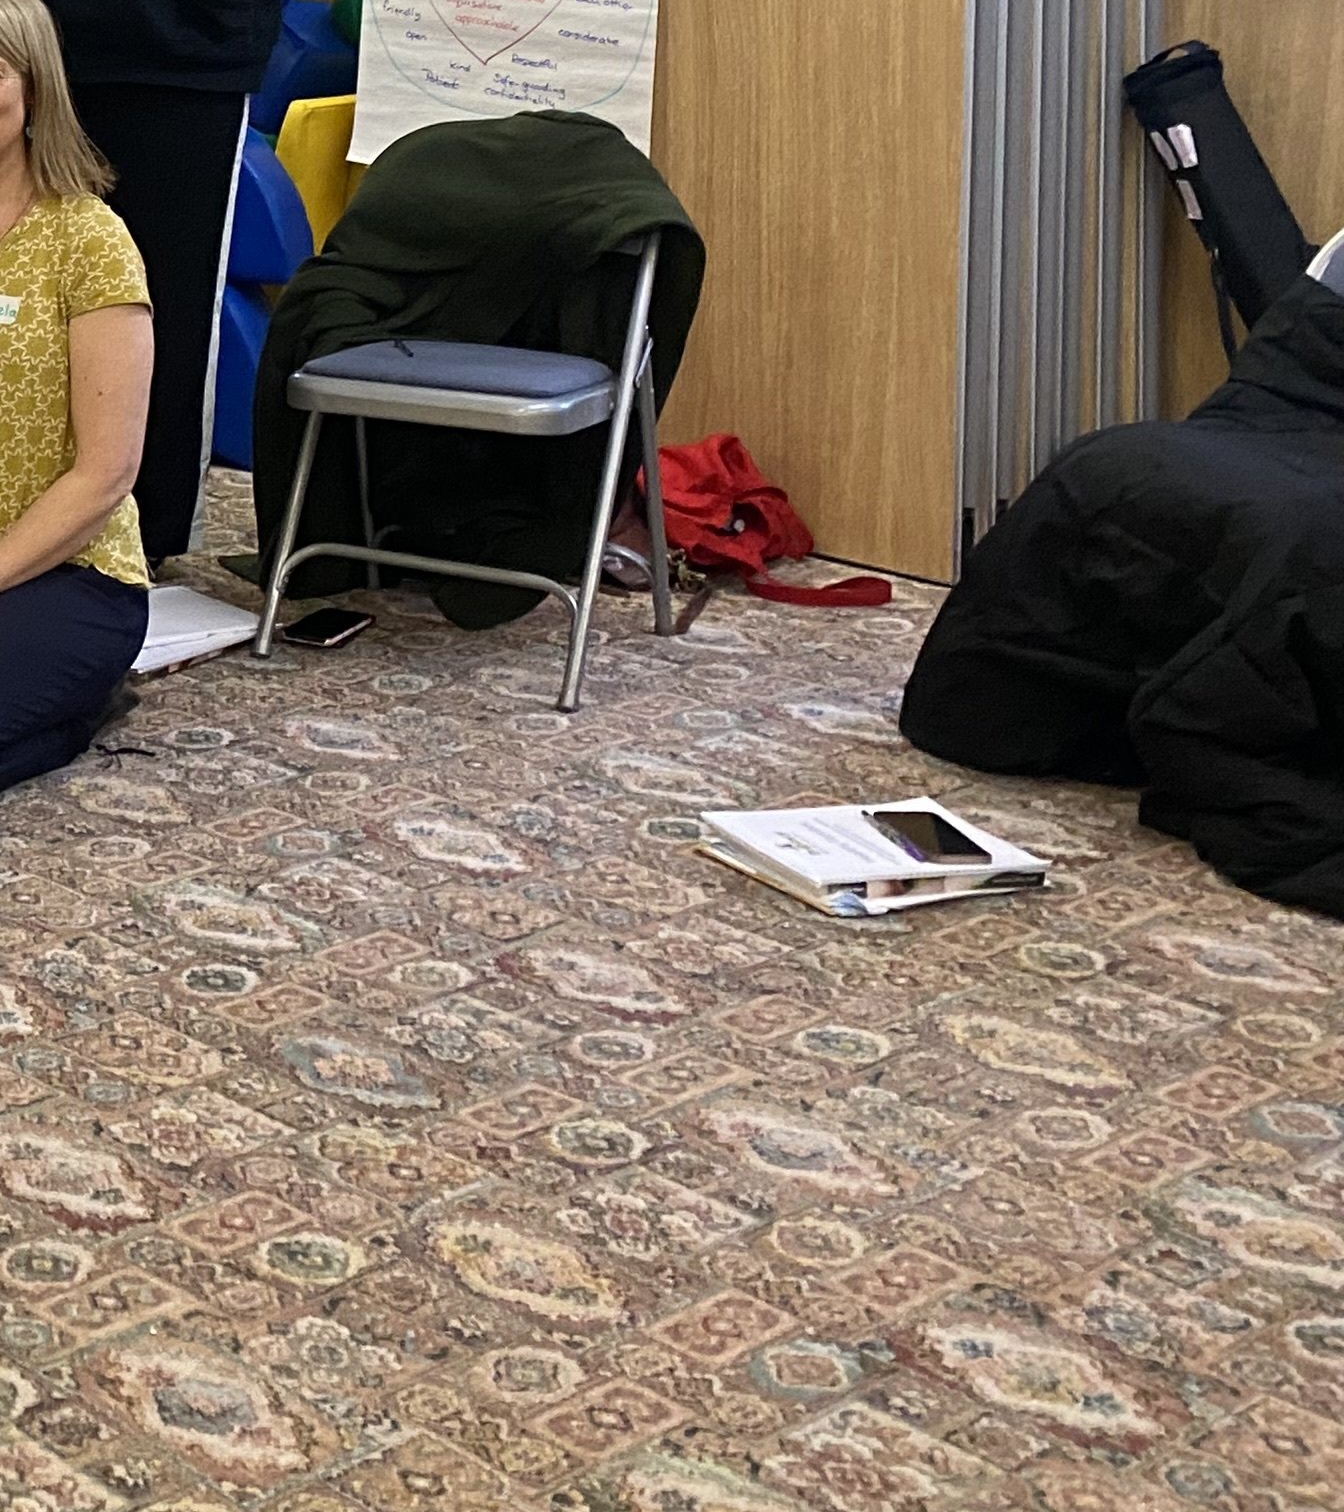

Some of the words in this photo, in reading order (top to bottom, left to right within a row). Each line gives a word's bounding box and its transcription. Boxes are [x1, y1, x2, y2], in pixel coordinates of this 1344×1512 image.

[383, 0, 421, 21] friendly
[603, 0, 633, 10] other
[558, 28, 619, 46] considerate
[483, 86, 555, 108] confidentiality
